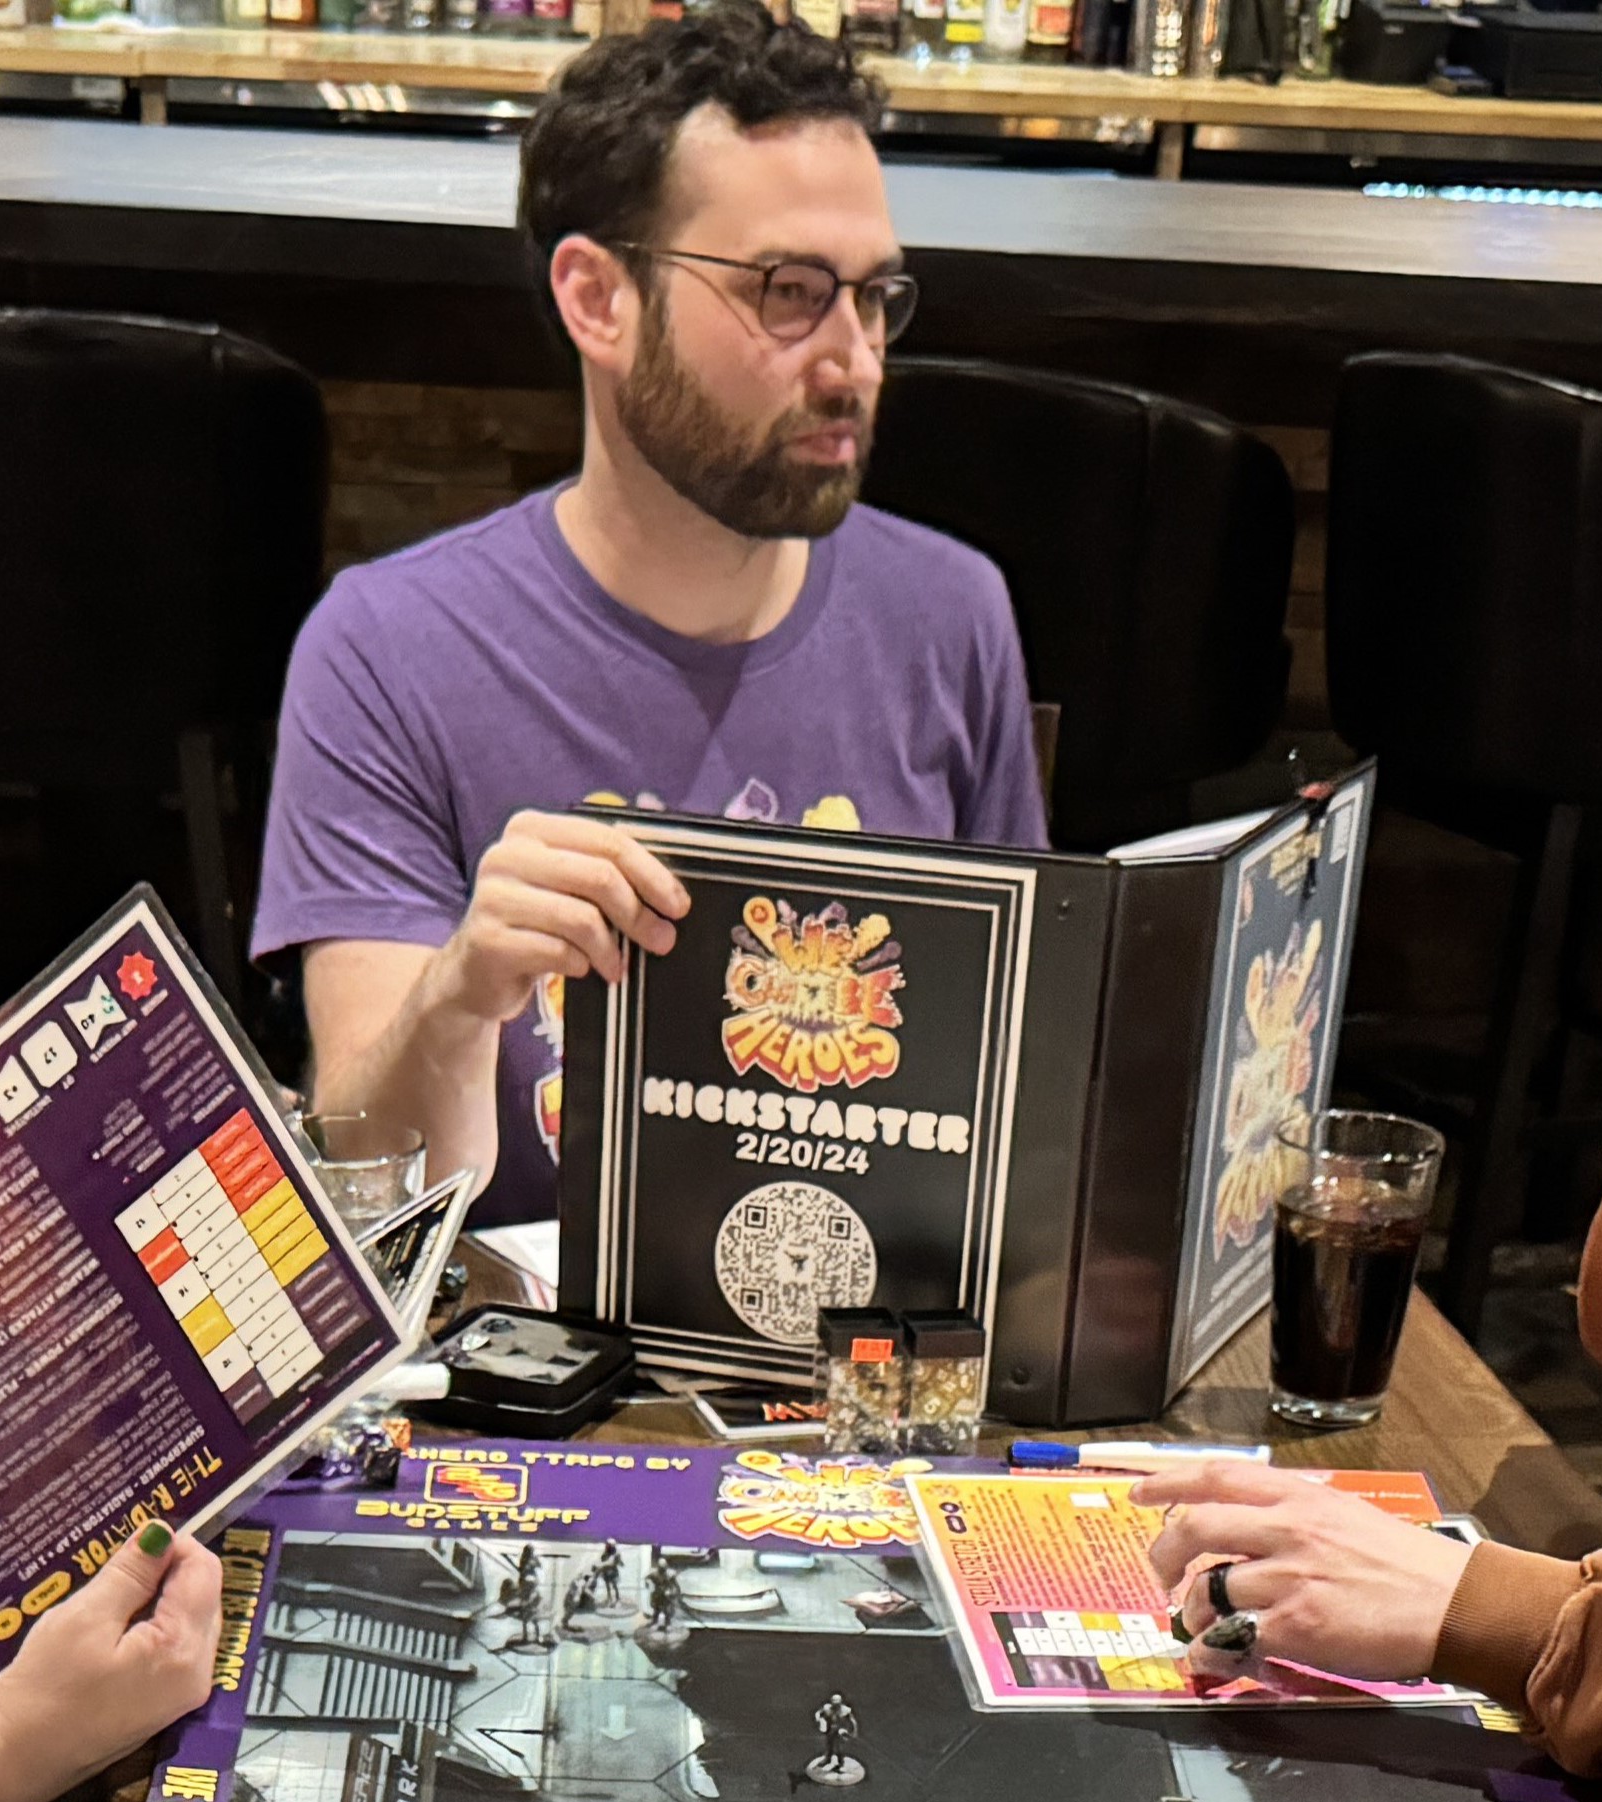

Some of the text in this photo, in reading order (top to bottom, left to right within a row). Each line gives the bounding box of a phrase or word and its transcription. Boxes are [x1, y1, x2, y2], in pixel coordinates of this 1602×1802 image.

[770, 913, 853, 971] WE
[79, 1012, 97, 1031] 40
[40, 1046, 58, 1065] 17
[722, 1009, 900, 1093] HEROES
[642, 1076, 970, 1155] KICKSTARTER
[735, 1132, 870, 1175] 2/20/24
[6, 1292, 57, 1337] ATTACKS
[79, 1423, 208, 1533] SUPERPOWER RADIATOR
[523, 1451, 691, 1471] TTRPG BY
[67, 1442, 224, 1578] THE RADIATOR
[355, 1502, 590, 1527] BUDSTUFF
[405, 1518, 540, 1533] GAMES
[719, 1507, 921, 1549] HEROE
[160, 1765, 220, 1802] WE
